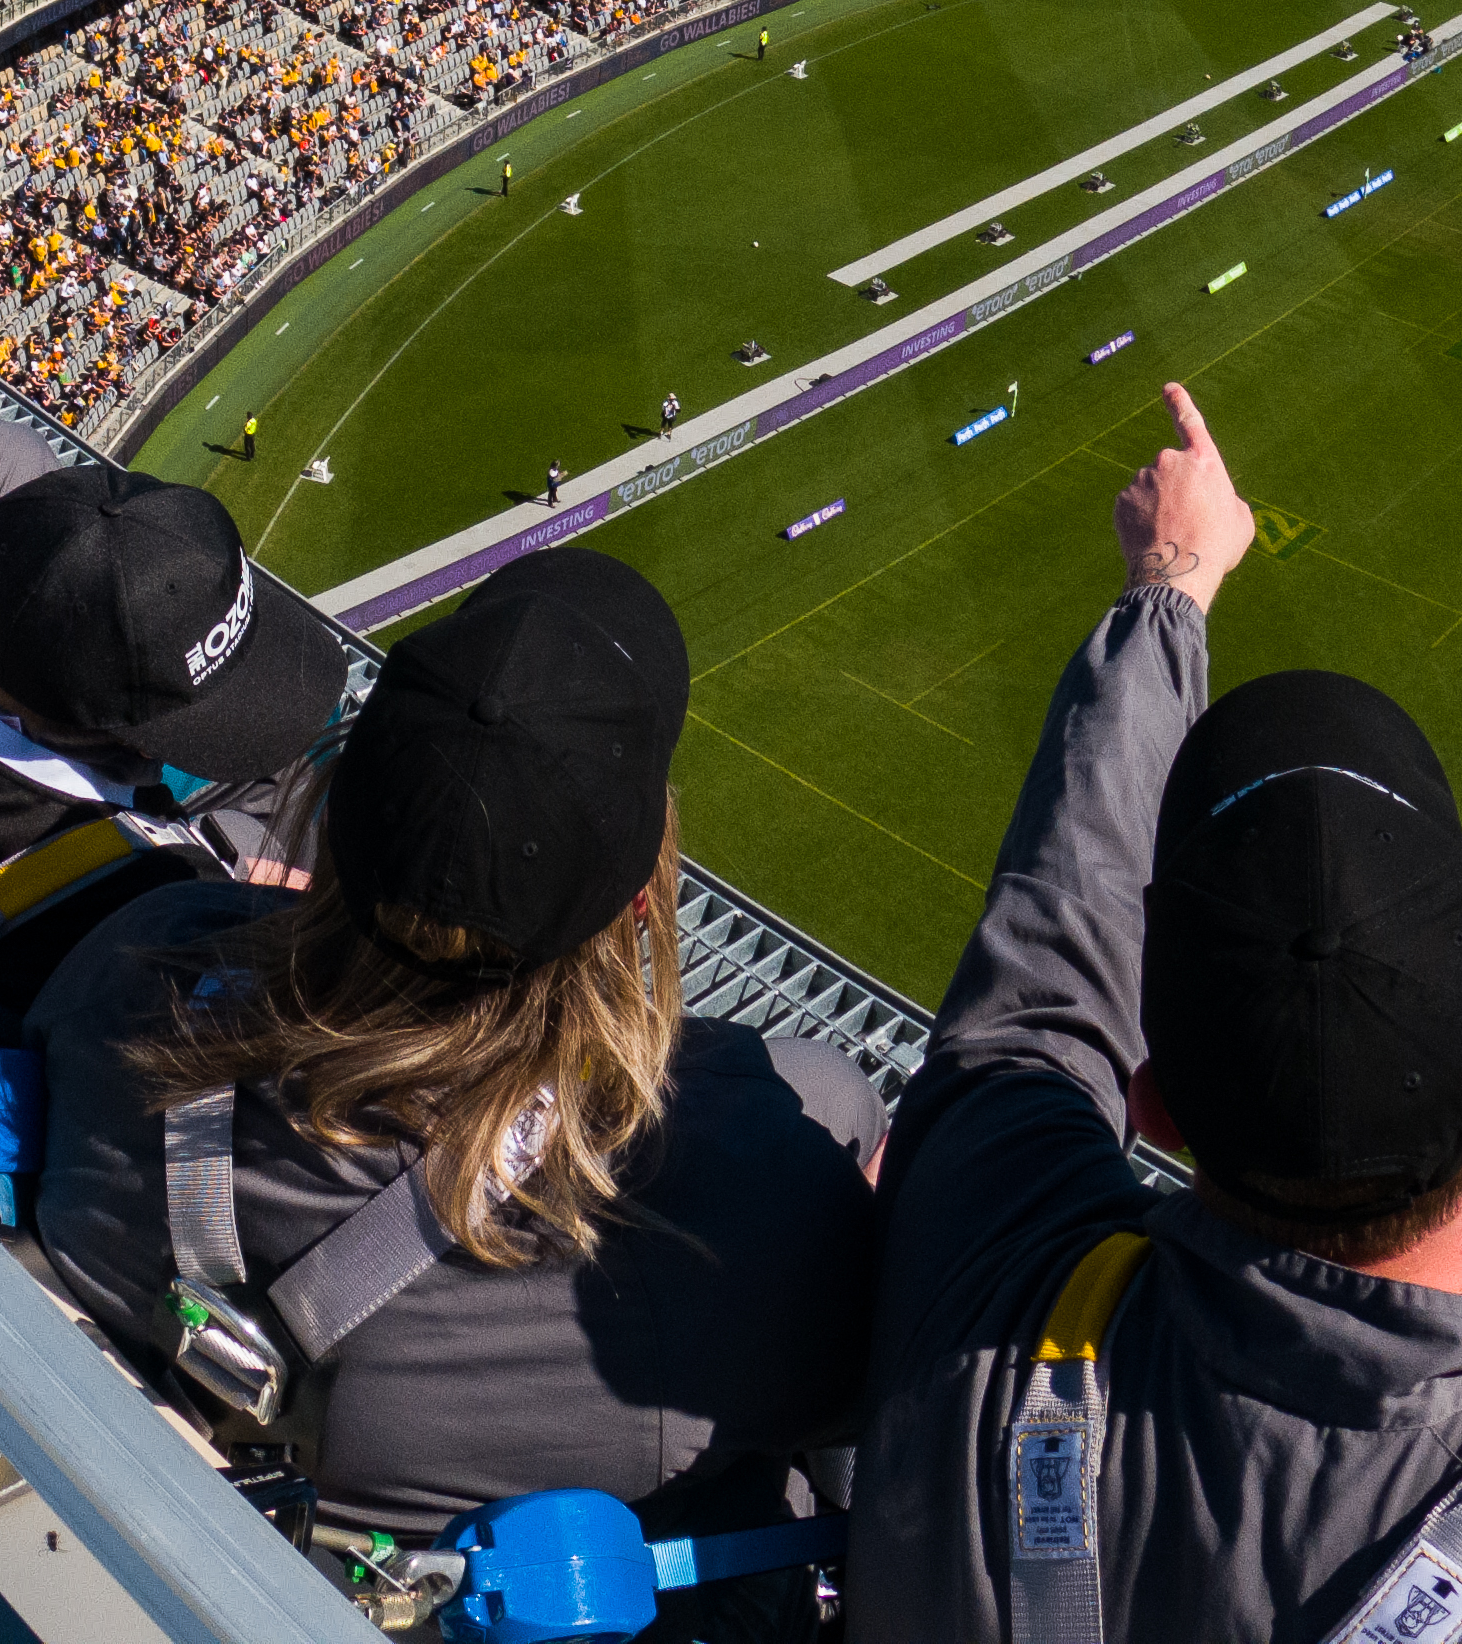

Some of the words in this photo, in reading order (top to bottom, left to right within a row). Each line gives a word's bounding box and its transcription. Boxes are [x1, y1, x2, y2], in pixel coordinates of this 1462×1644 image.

[660, 30, 681, 51] GO
[682, 0, 761, 41] WALLABIES!
[473, 129, 494, 152] GO
[496, 82, 571, 135] WALLABIES!
[901, 321, 956, 359] INVESTING
[520, 505, 595, 551] INVESTING
[184, 641, 208, 677] THE
[204, 546, 250, 658] OZO
[192, 655, 225, 686] OPTUS
[225, 612, 251, 657] STADIUM
